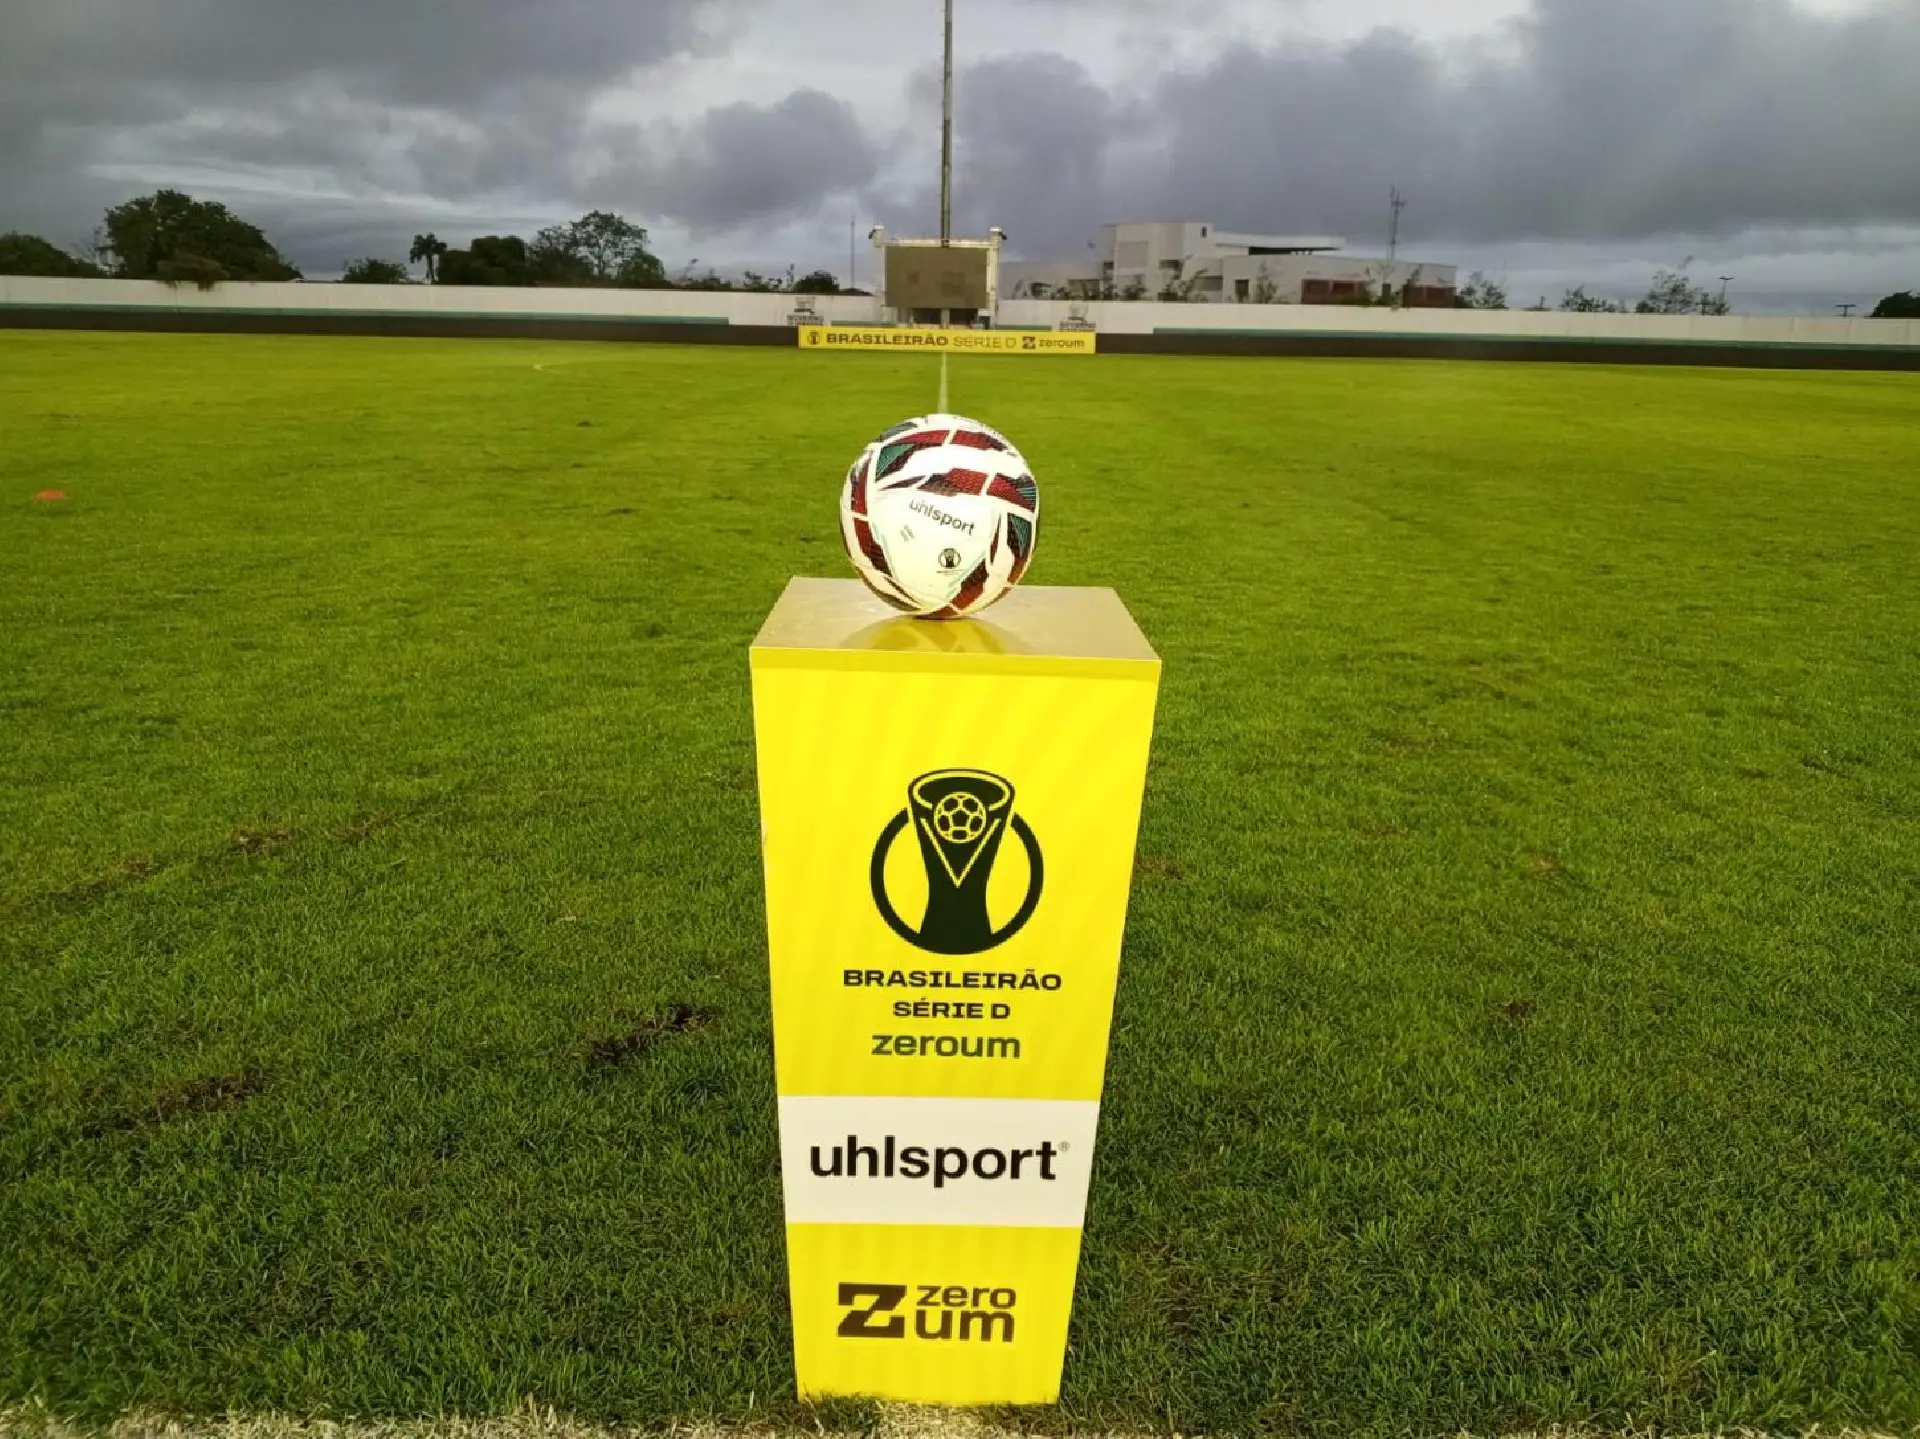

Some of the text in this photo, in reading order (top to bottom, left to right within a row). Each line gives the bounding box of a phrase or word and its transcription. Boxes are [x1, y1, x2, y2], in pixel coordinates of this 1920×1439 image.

[826, 332, 948, 346] BRASILEIRÃO
[1005, 337, 1017, 349] D
[1038, 337, 1084, 349] zeroum
[909, 499, 975, 536] uhlsport
[843, 969, 1062, 990] BRASILEIRÃO
[893, 998, 1010, 1019] SÉRIE D
[871, 1035, 1020, 1059] zeroum
[916, 1285, 1016, 1309] zero
[915, 1309, 1015, 1342] um
